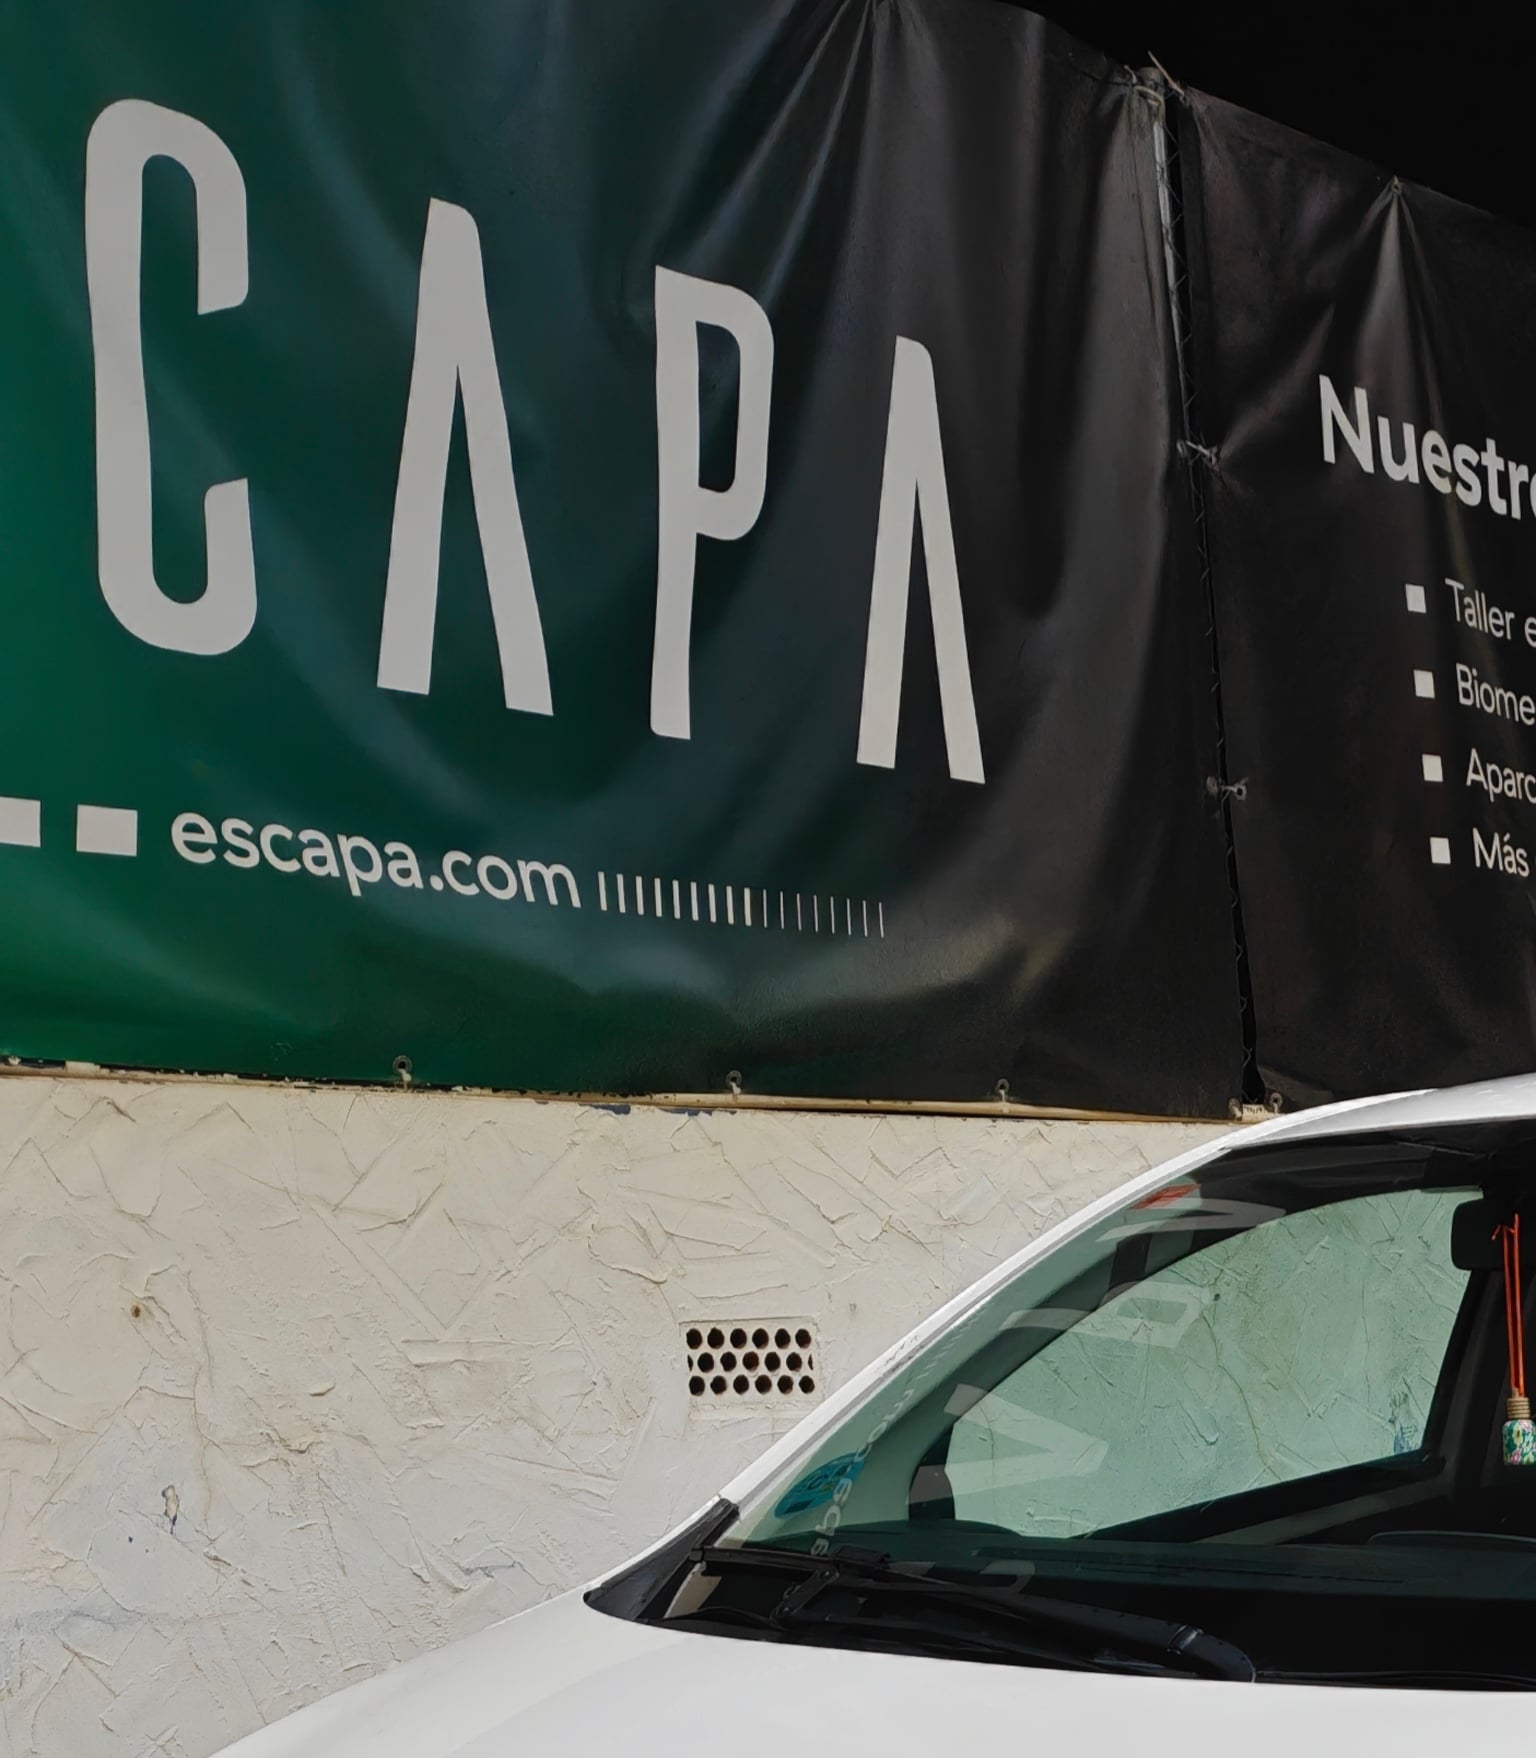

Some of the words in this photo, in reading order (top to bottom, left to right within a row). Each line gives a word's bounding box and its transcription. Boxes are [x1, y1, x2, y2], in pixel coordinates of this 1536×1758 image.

[85, 98, 985, 784] CAPA
[1445, 577, 1514, 640] Taller
[171, 809, 582, 909] escapa.com
[1472, 828, 1529, 878] Más
